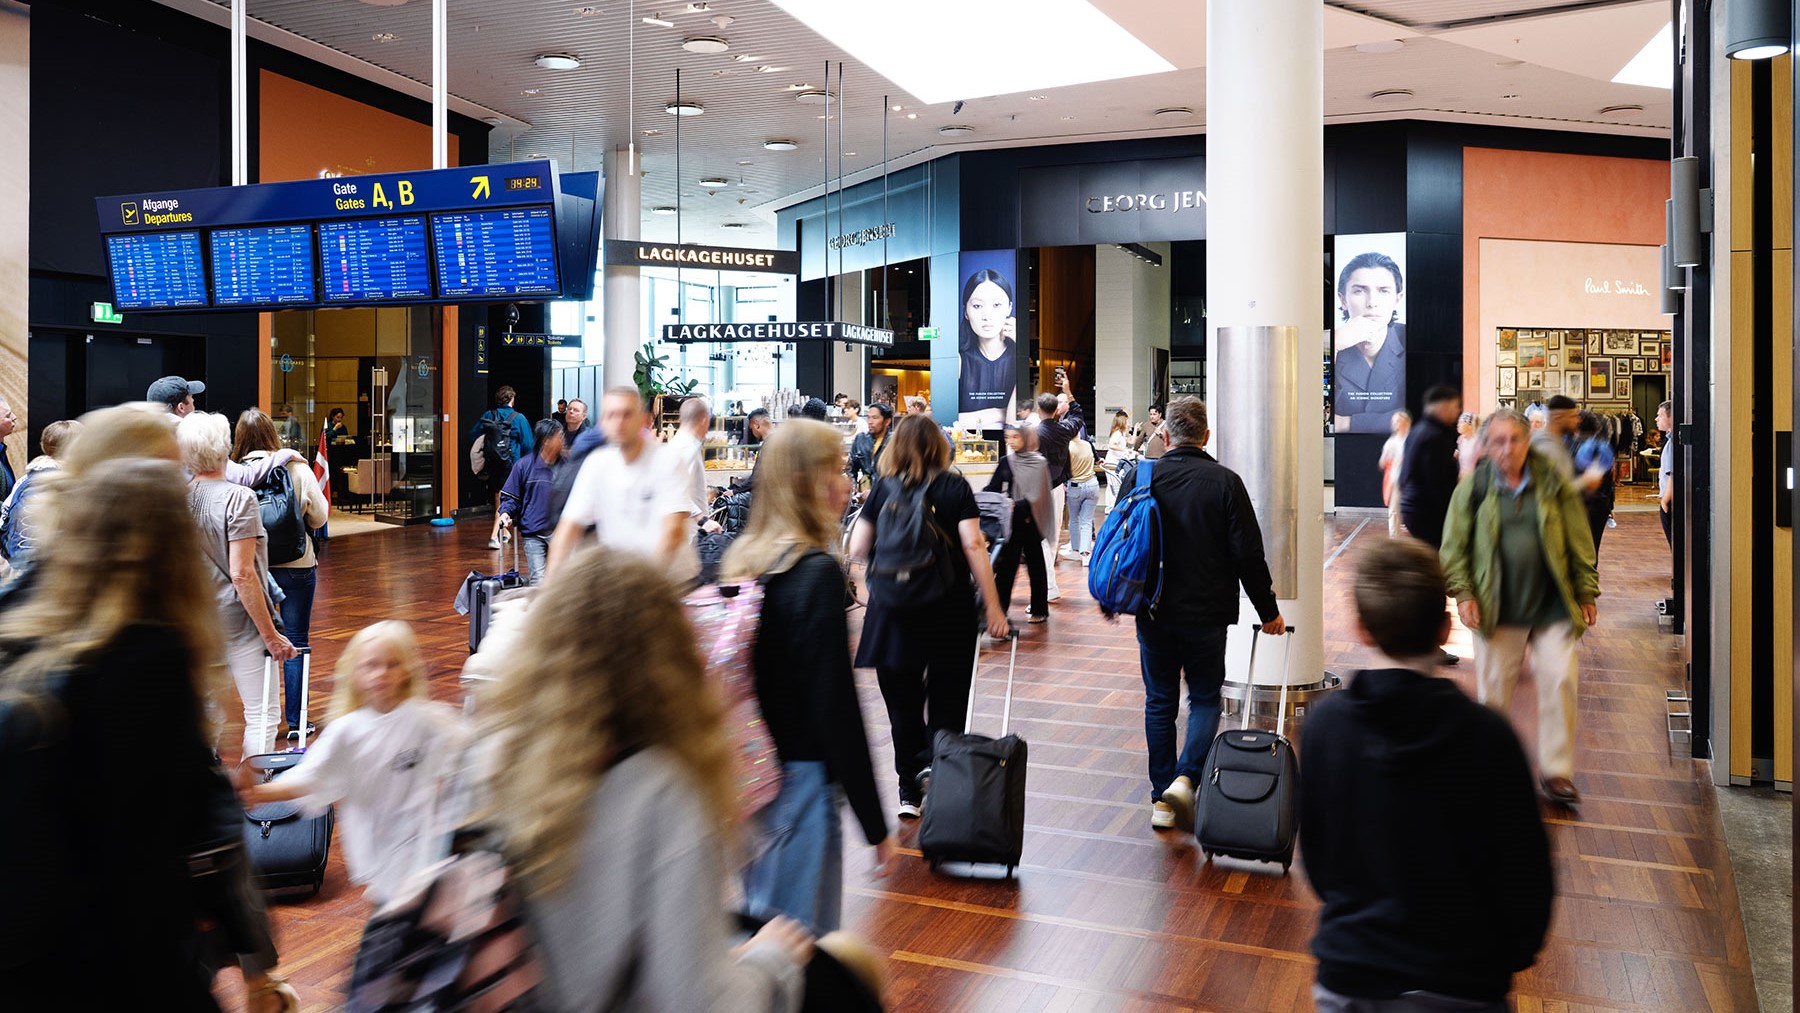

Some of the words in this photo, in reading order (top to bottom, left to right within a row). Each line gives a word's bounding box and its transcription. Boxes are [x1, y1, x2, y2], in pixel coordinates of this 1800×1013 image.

[333, 182, 357, 195] Gate
[372, 182, 394, 210] A,
[398, 180, 415, 206] B
[142, 199, 178, 212] Afgange
[335, 197, 365, 211] Gates
[144, 212, 193, 226] Departures
[639, 247, 774, 267] LAGKAGEHUSET
[1585, 277, 1611, 294] Paul
[1615, 280, 1651, 296] Smith
[667, 323, 835, 339] LAGKAGEHUSET
[842, 326, 893, 344] LAGKAGEHUSET
